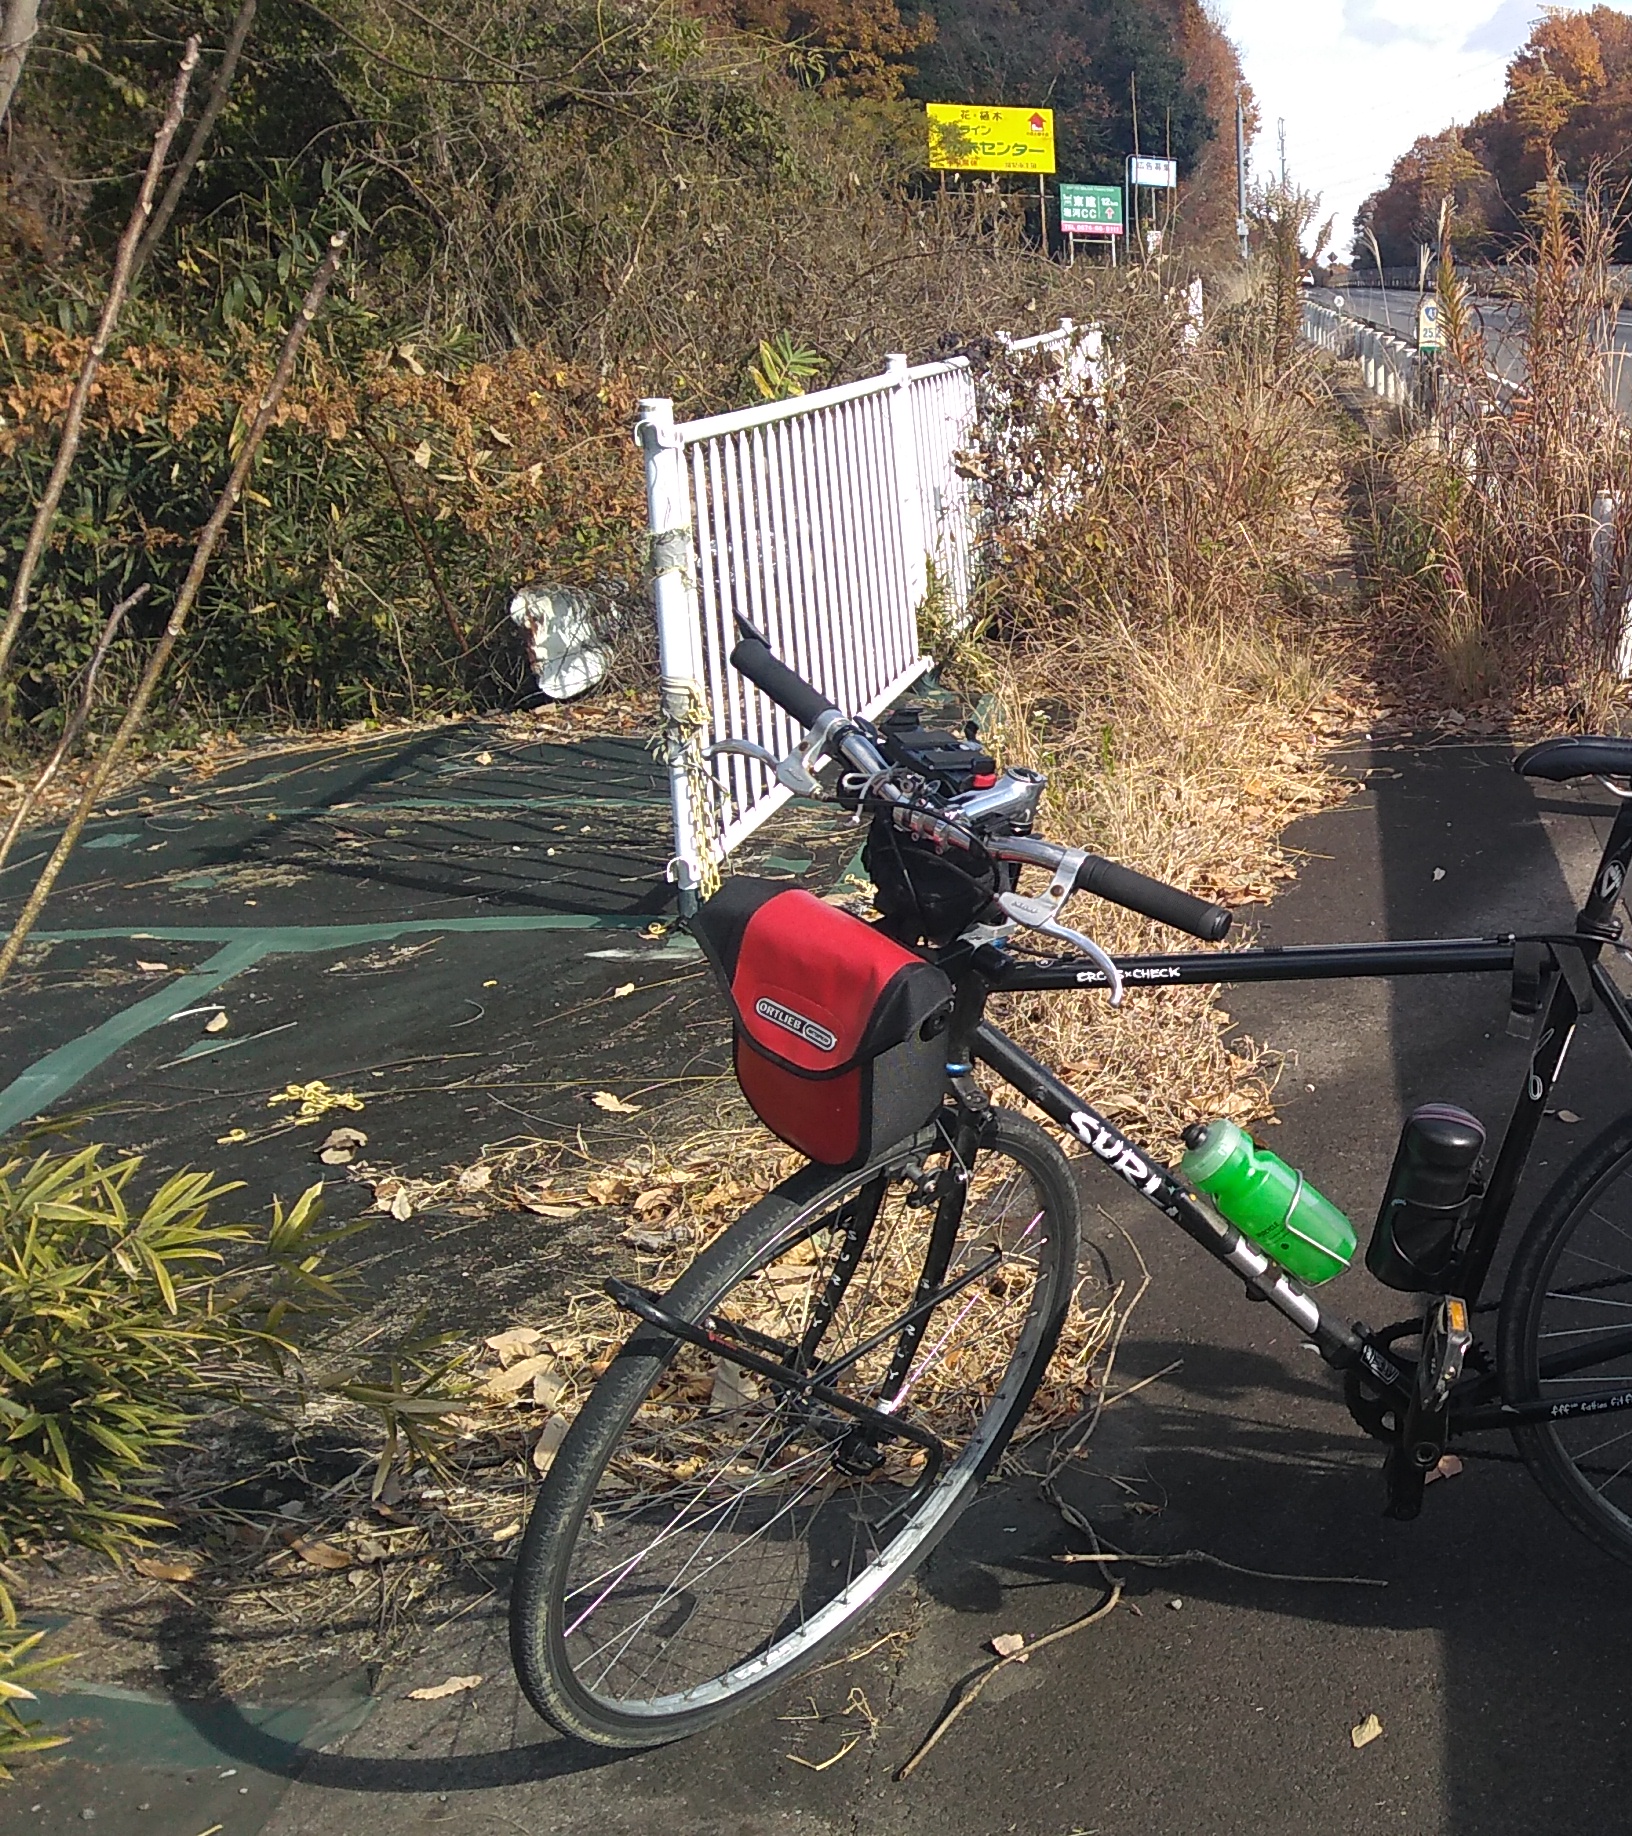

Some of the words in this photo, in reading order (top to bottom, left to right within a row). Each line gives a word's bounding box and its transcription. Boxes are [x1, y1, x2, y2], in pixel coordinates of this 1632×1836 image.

[958, 140, 1045, 157] 木センター
[759, 1002, 802, 1030] ORTLIEB
[888, 1277, 931, 1380] SRLY
